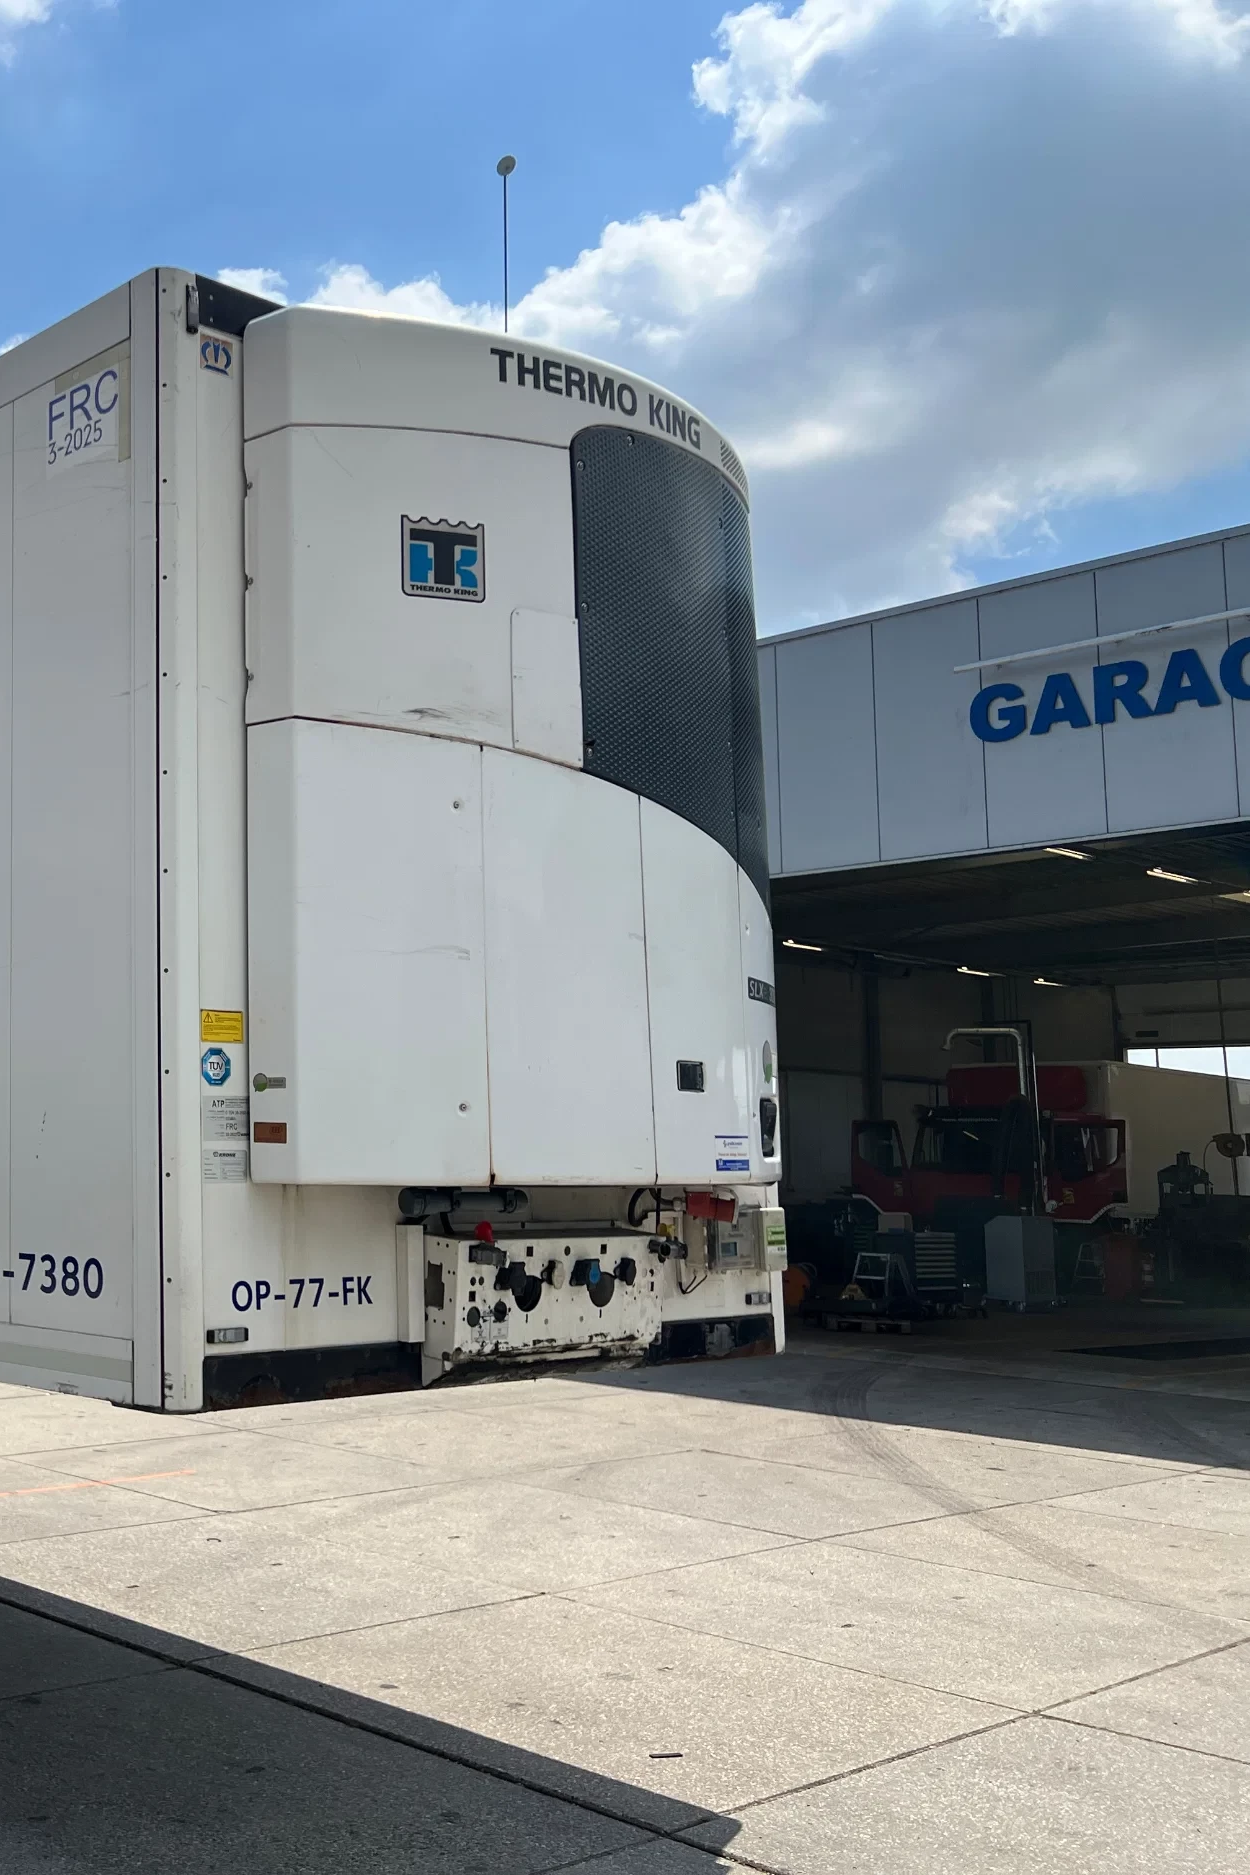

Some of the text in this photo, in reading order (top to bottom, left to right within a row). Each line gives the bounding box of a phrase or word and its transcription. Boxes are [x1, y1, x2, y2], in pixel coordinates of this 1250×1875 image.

[48, 369, 119, 441] FRC
[490, 347, 701, 450] THERMO KING
[47, 419, 103, 465] 3-2025
[410, 584, 479, 597] THERMO KING
[749, 980, 764, 999] SLX
[211, 1099, 225, 1108] ATP
[225, 1122, 238, 1131] FRC
[231, 1275, 374, 1313] OP-77-FK
